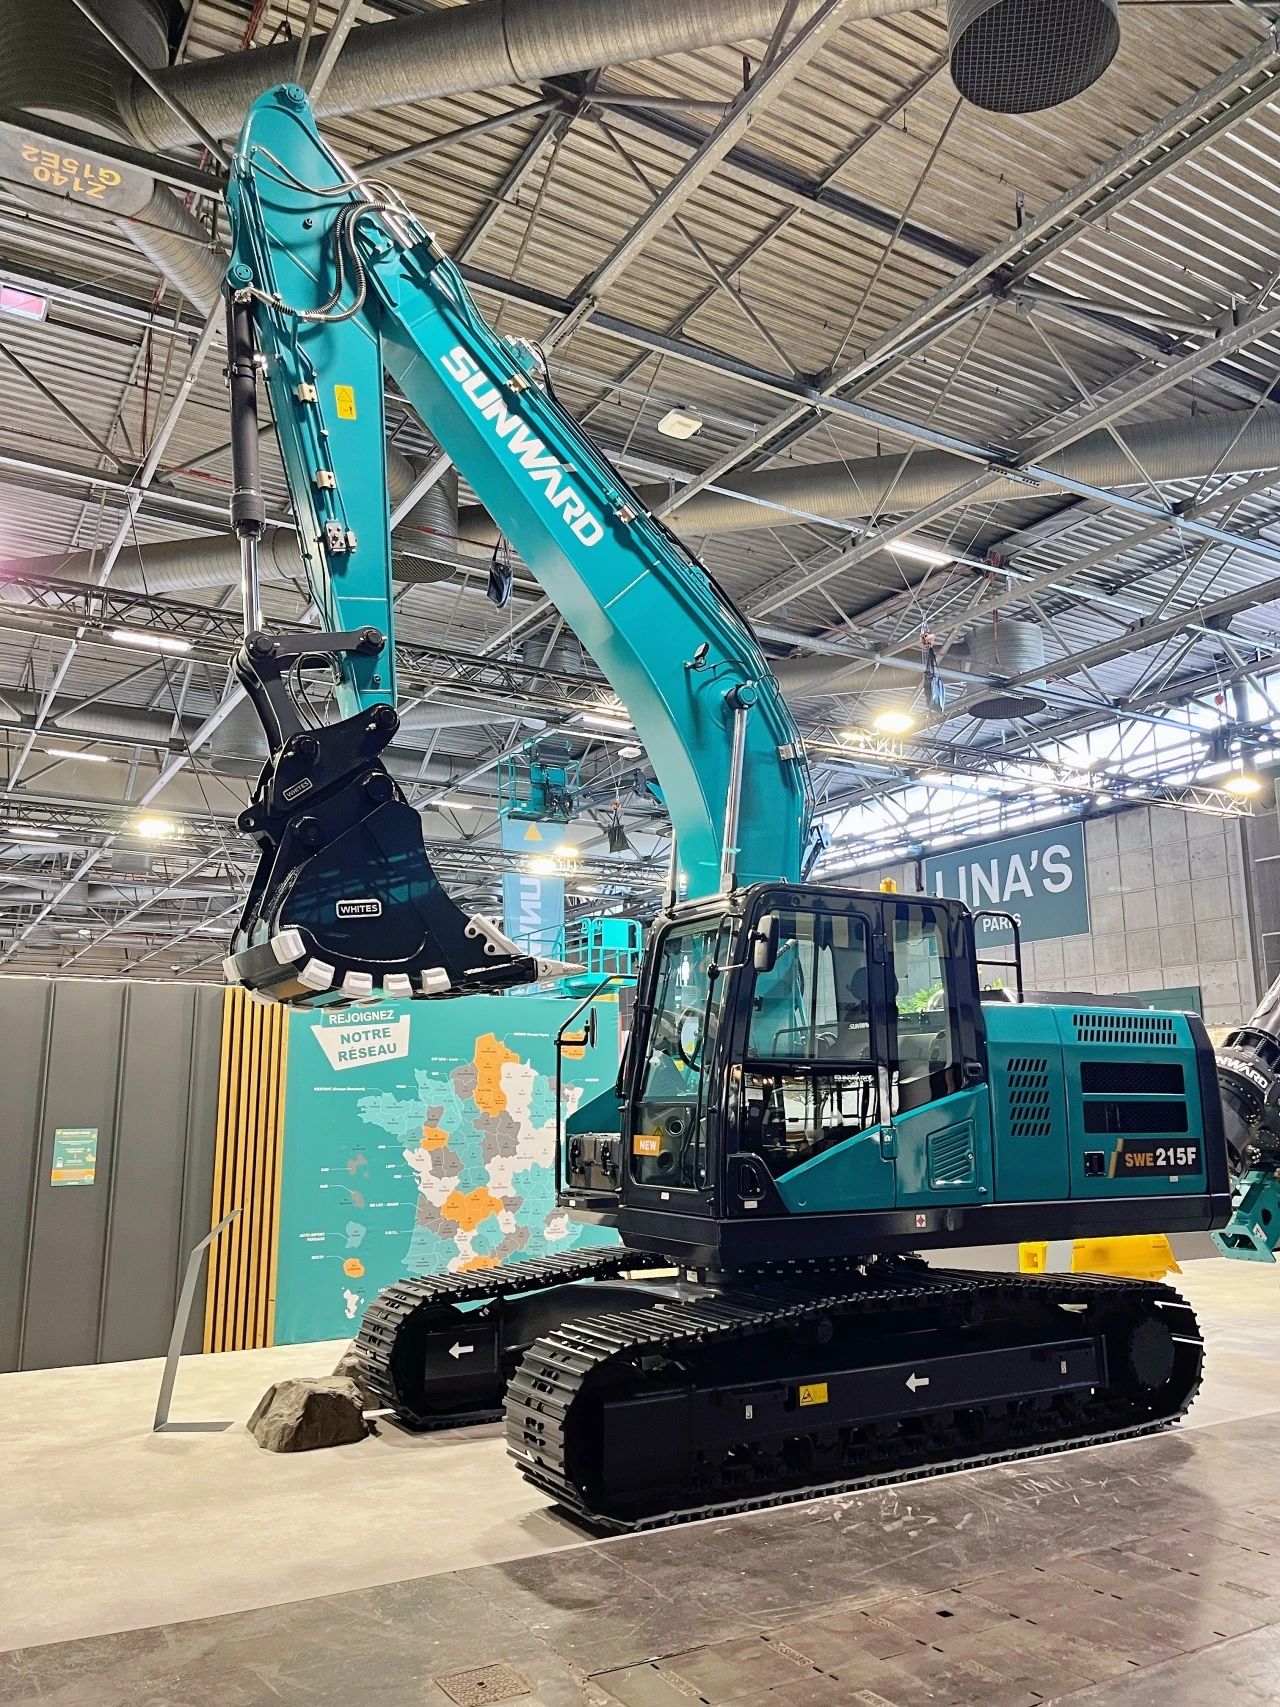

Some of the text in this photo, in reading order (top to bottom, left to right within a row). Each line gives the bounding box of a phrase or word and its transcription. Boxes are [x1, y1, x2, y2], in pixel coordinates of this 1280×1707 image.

[21, 144, 121, 186] G15E2
[33, 165, 107, 199] Z140
[440, 346, 605, 547] SUNWARD
[340, 904, 378, 914] WHITES
[329, 1010, 396, 1025] REJOIGNEZ
[340, 1027, 392, 1045] NOTRE
[338, 1043, 397, 1062] RÉSEAU
[639, 1140, 657, 1151] NEW
